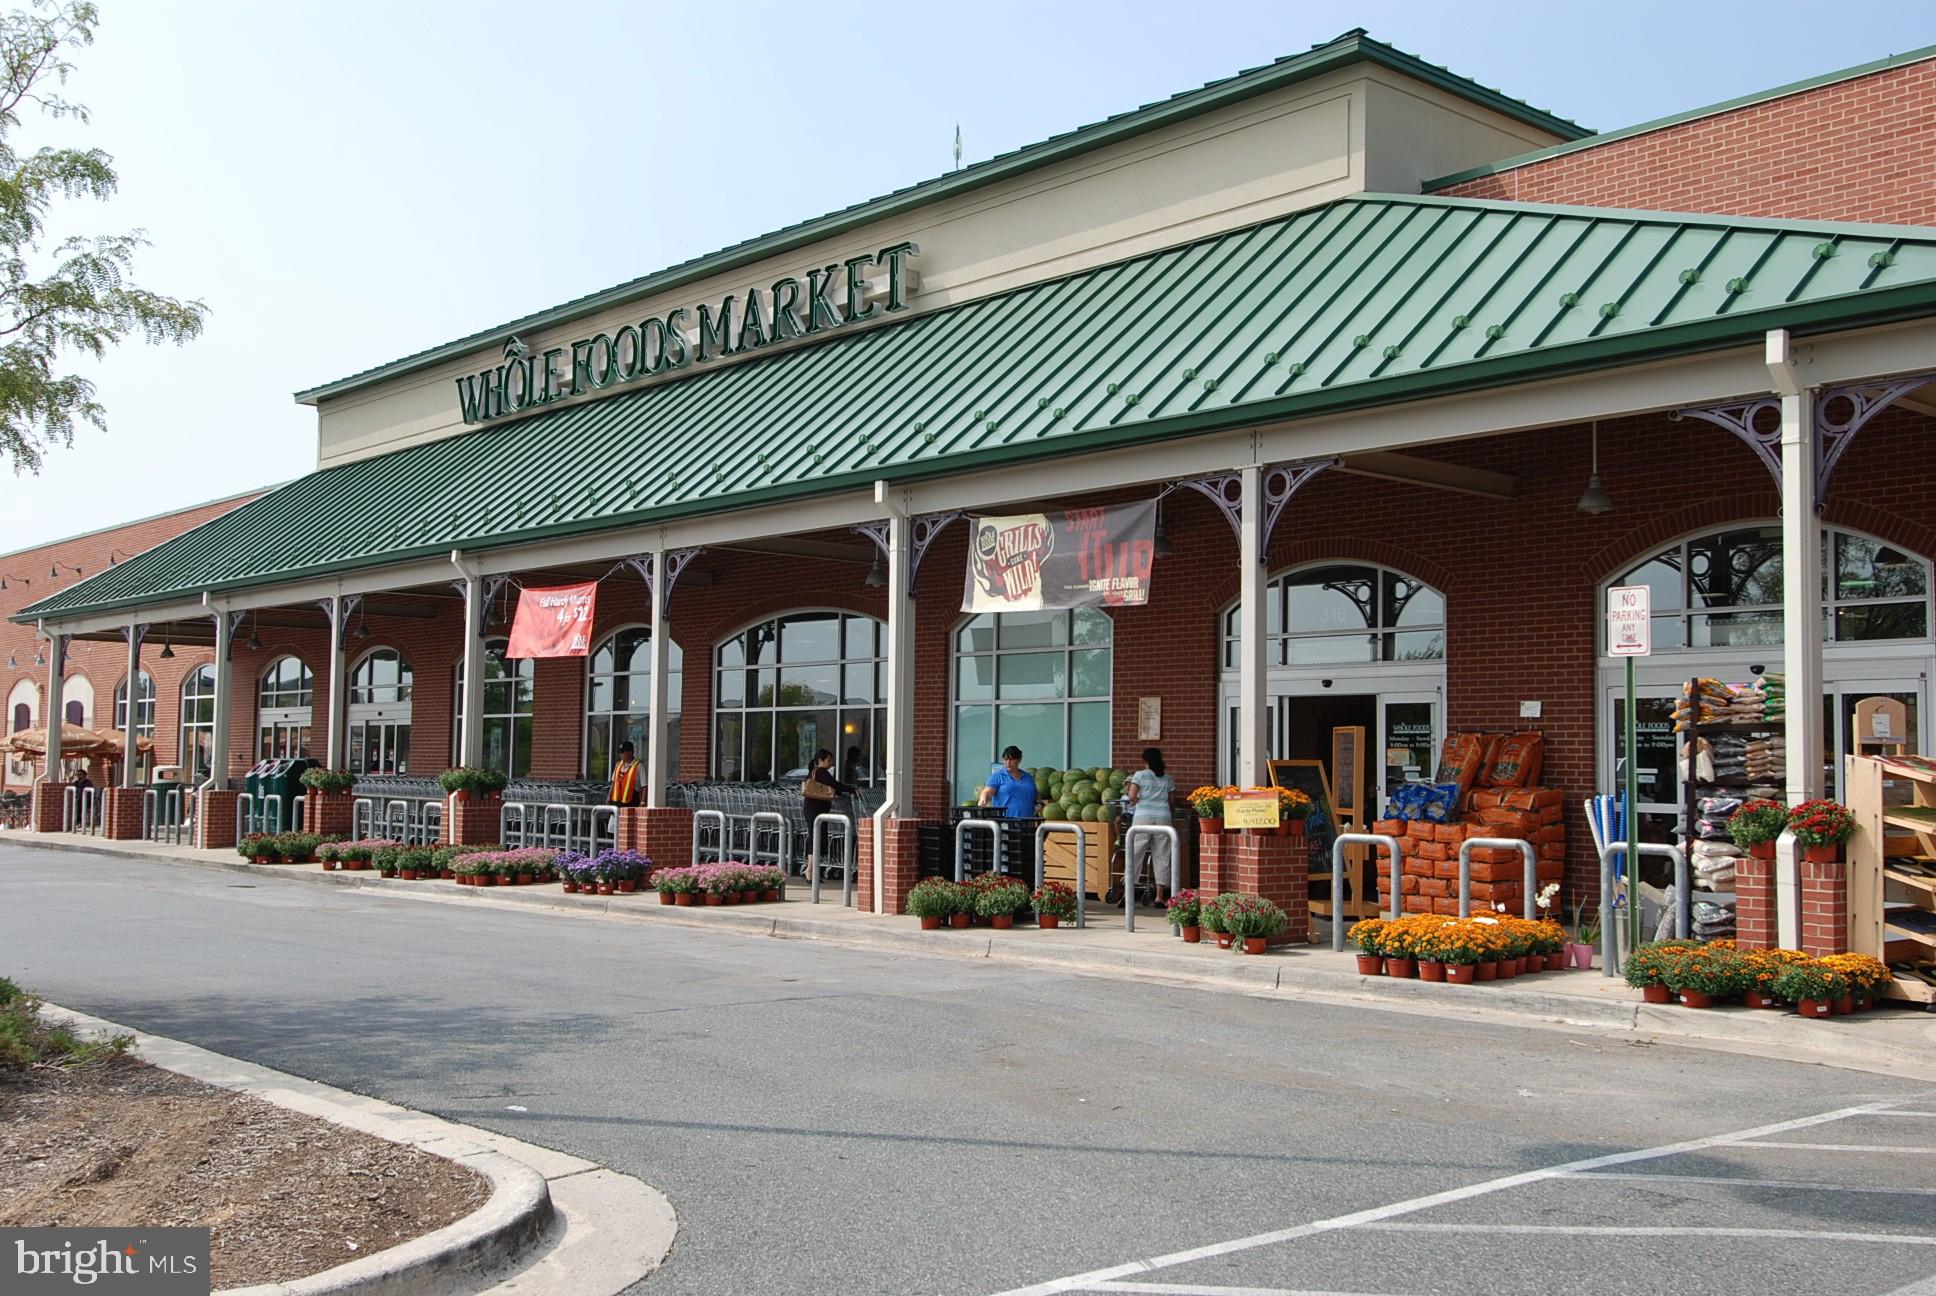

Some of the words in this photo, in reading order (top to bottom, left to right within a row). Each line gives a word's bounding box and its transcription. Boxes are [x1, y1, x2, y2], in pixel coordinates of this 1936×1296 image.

[569, 307, 692, 397] FOODS
[696, 241, 921, 363] MARKET
[1064, 507, 1105, 534] START
[997, 525, 1042, 568] GRILLS
[1077, 529, 1108, 581] IT
[1002, 551, 1040, 599] WILD!
[1089, 578, 1111, 592] IGNITE
[550, 595, 568, 609] Hardy
[1123, 588, 1146, 602] GRILL!
[1622, 593, 1636, 607] NO
[556, 607, 565, 623] 4
[1319, 607, 1347, 623] 316
[1611, 609, 1646, 622] PARKING
[1621, 623, 1636, 632] ANY
[1621, 633, 1637, 643] TIME
